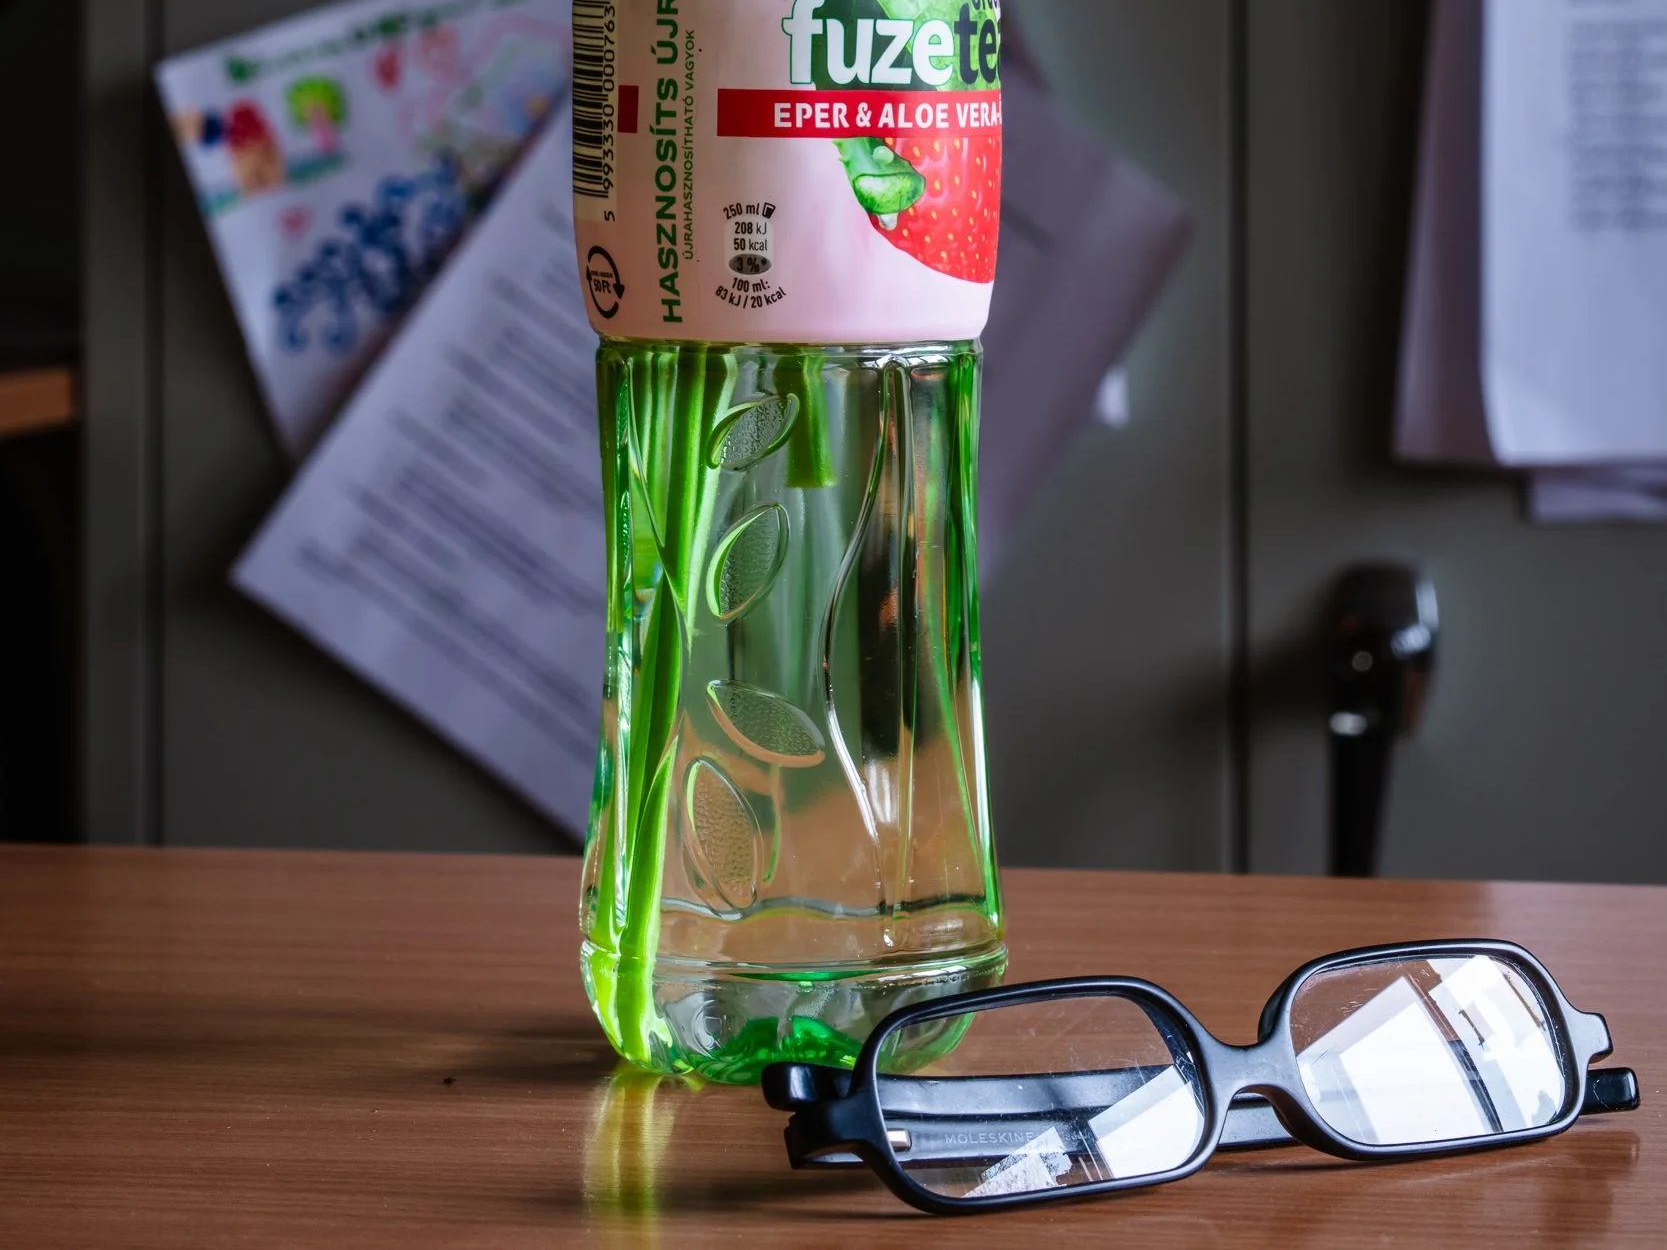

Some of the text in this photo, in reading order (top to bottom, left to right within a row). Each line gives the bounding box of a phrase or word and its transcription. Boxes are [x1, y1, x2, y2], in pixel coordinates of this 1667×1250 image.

[602, 5, 615, 222] 5 993330 000763
[774, 103, 849, 128] EPER
[855, 103, 872, 128] &
[878, 103, 949, 128] ALOE
[683, 30, 695, 260] ÚJRAHASZNOSÍTHATÓ VAGYOK
[649, 78, 683, 323] HASZNOSÍTS
[723, 203, 760, 219] 250 ml
[735, 222, 767, 235] 208 kJ
[734, 238, 768, 251] 50 kcal
[732, 277, 770, 293] 100 ml:
[715, 286, 728, 300] 83
[728, 293, 741, 307] kJ
[751, 295, 763, 308] 20
[764, 287, 787, 305] kcal
